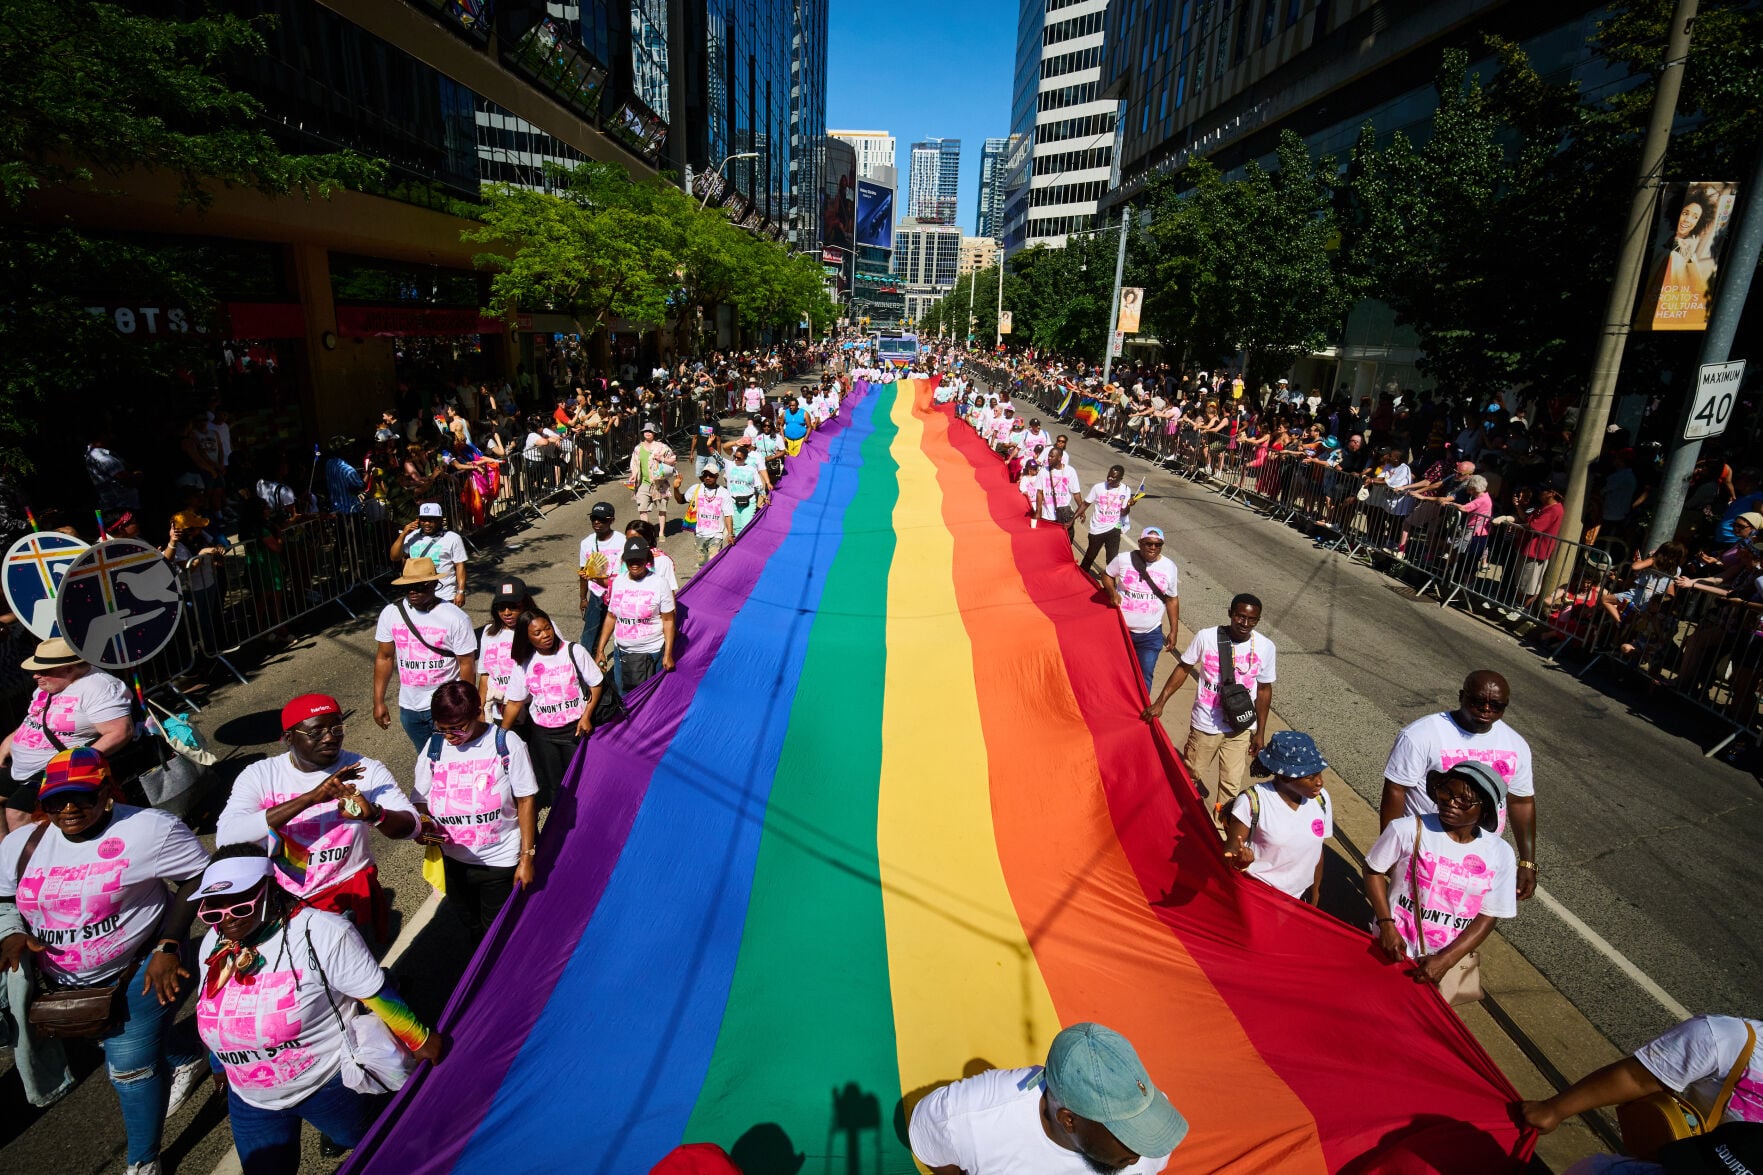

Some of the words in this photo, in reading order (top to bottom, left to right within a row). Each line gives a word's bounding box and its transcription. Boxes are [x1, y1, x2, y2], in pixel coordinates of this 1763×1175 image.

[1661, 302, 1706, 310] CULTURA
[1655, 311, 1688, 319] HEART
[1703, 369, 1741, 385] MAXIMUM
[1694, 393, 1732, 426] 40
[405, 660, 426, 669] WON'T
[540, 703, 562, 714] WON'T
[438, 814, 472, 825] WON'T
[476, 808, 501, 824] STOP
[319, 846, 350, 863] STOP
[1399, 893, 1415, 913] WE
[37, 928, 77, 945] WON'T
[83, 914, 120, 940] STOP
[216, 1050, 261, 1066] WON'T
